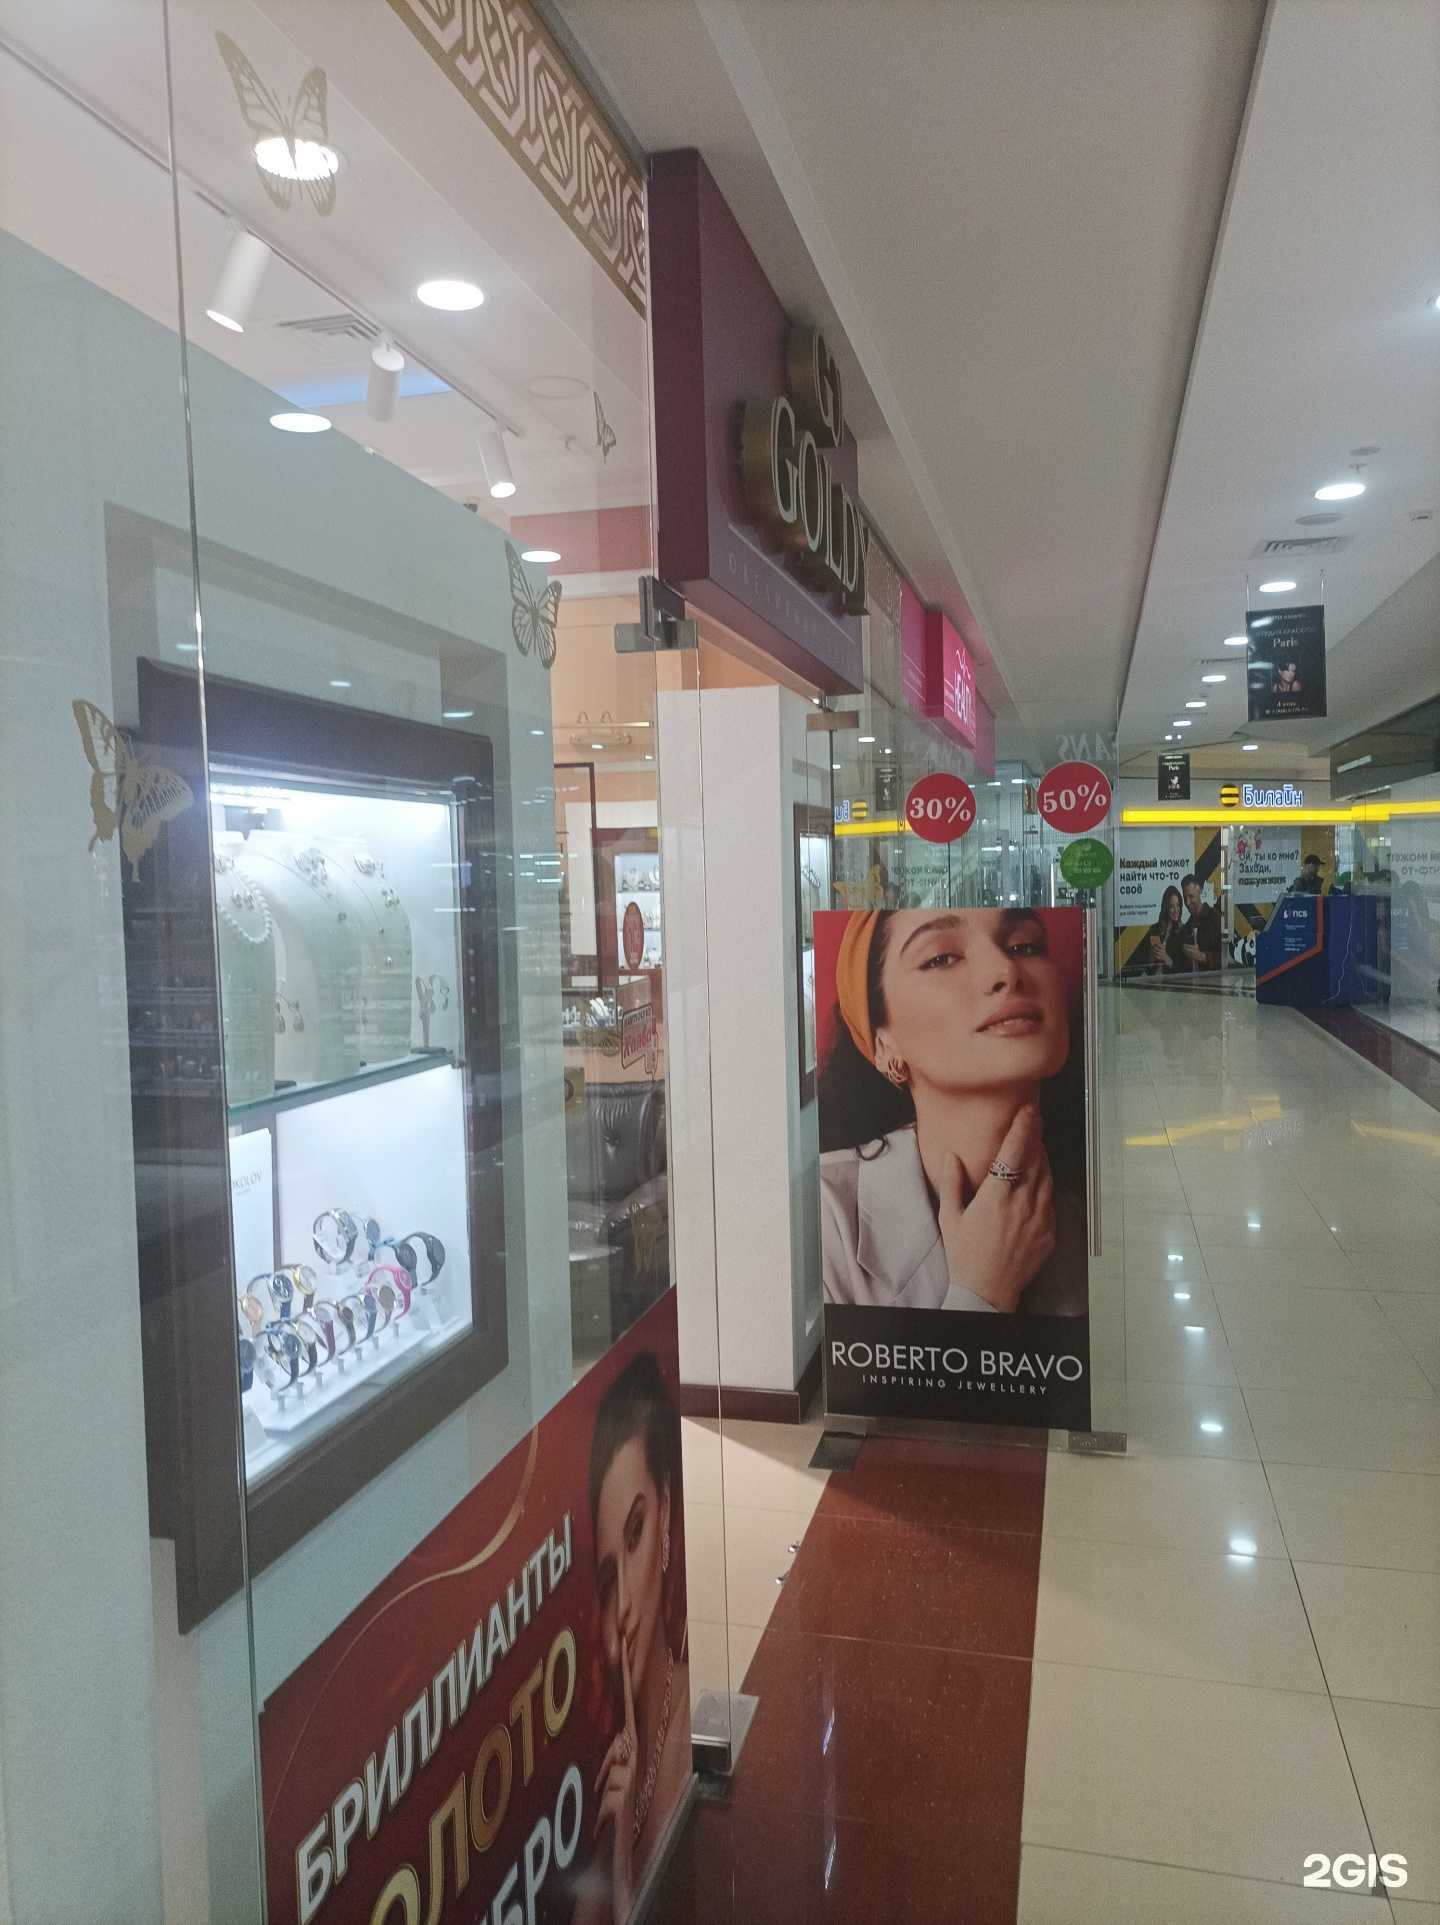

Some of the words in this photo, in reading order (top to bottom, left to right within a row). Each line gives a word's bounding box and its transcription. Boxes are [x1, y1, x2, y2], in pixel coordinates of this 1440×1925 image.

[1042, 781, 1107, 813] 50%
[1242, 783, 1303, 808] Билайн
[909, 796, 971, 824] 30%
[1119, 857, 1158, 870] Каждый
[1160, 859, 1190, 869] может
[1239, 862, 1272, 874] Заходи,
[1119, 870, 1148, 882] найти
[1149, 871, 1180, 881] что-то
[1119, 883, 1143, 895] своё
[831, 1341, 968, 1374] ROBERTO
[980, 1350, 1083, 1382] BRAVO
[862, 1374, 946, 1390] INSPIRING
[957, 1380, 1048, 1396] JEWELLERY
[296, 1509, 572, 1925] БРИЛЛИАНТЫ
